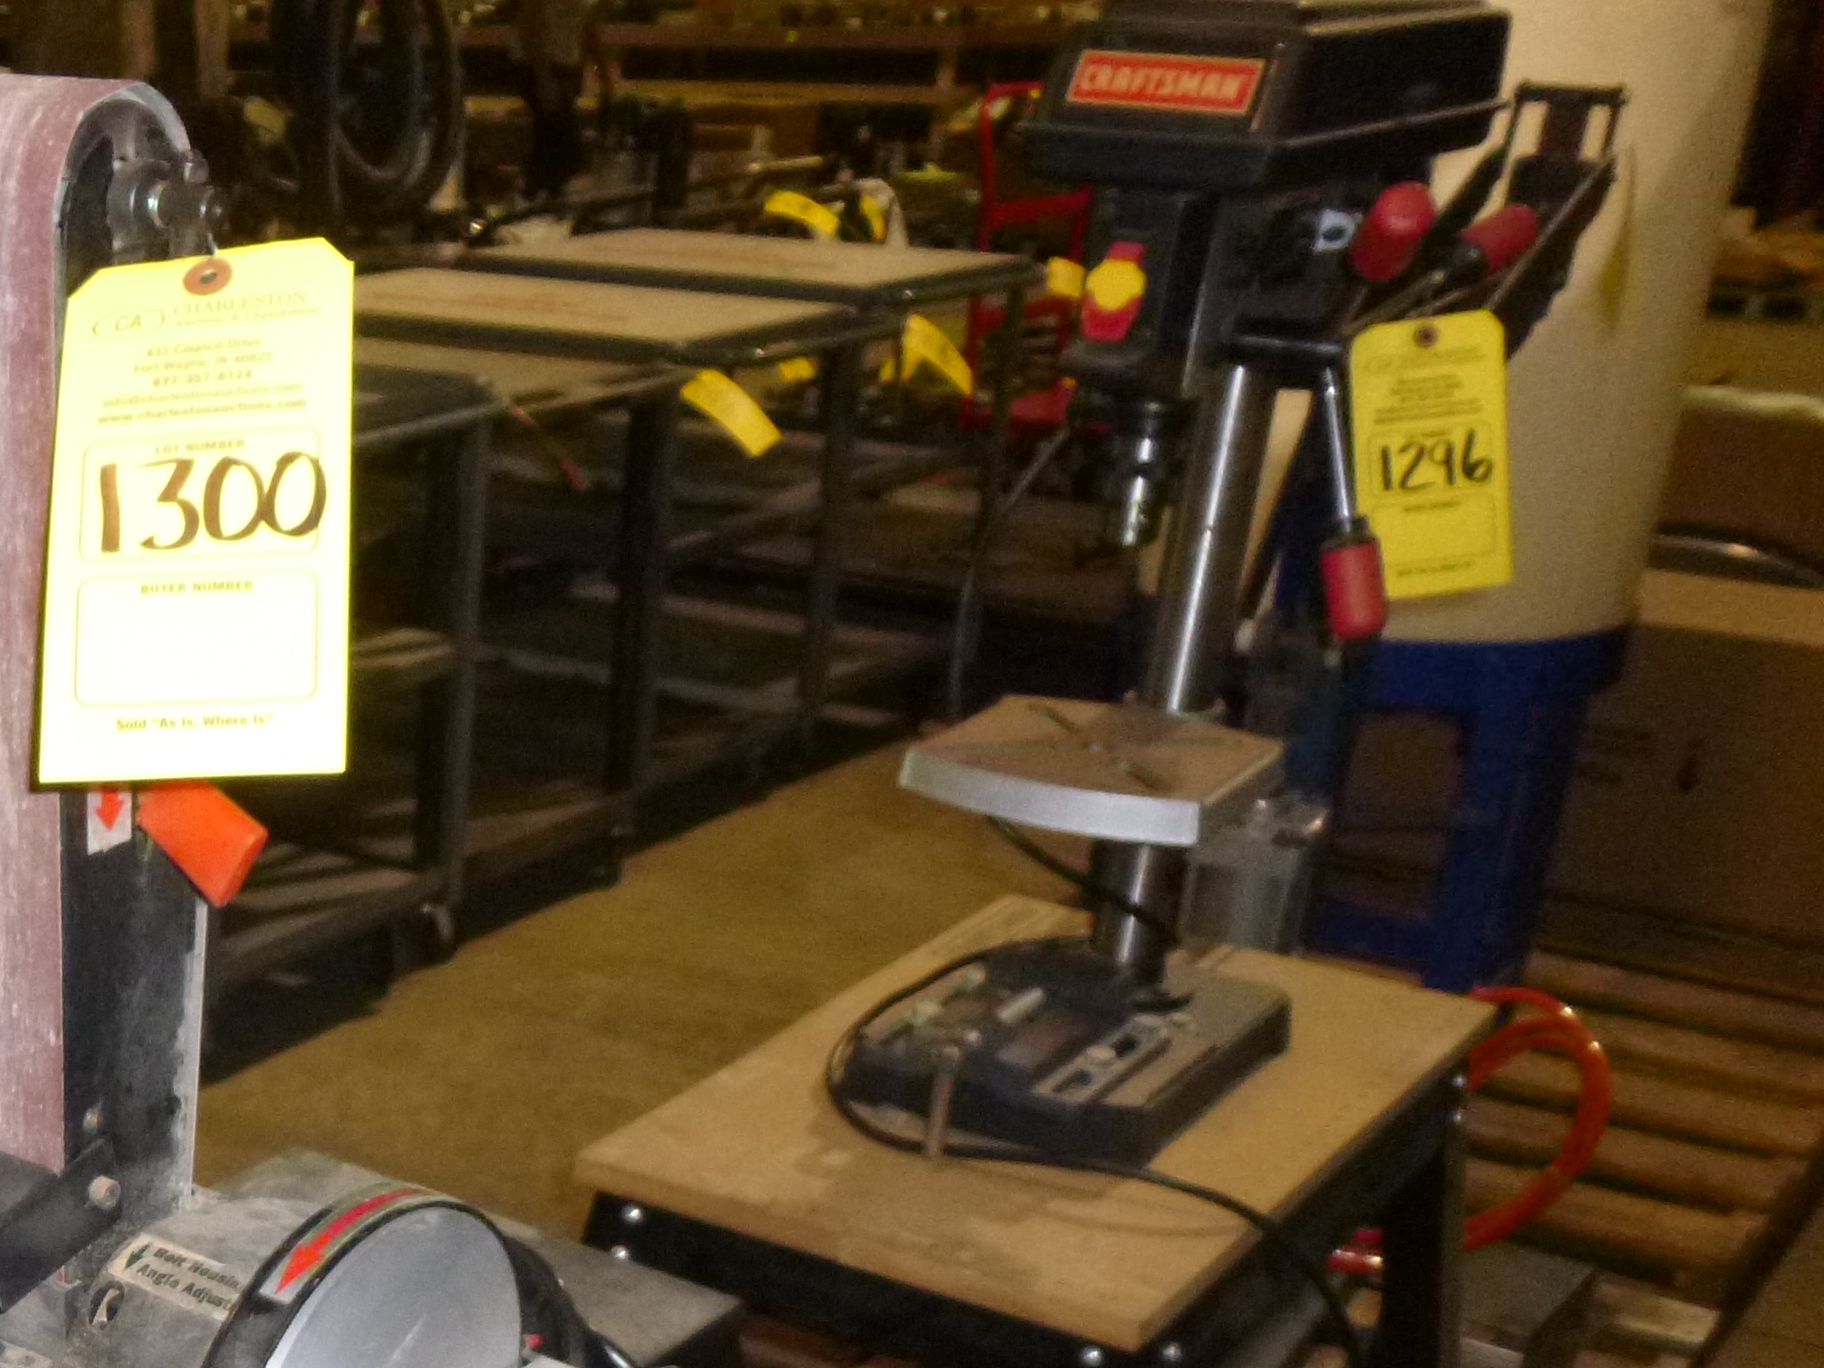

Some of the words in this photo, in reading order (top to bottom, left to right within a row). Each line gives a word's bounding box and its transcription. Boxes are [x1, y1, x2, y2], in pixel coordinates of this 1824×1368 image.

[1080, 63, 1245, 100] CRAFTSMAN
[114, 314, 142, 331] CA
[185, 438, 245, 452] NUMBER
[1381, 428, 1493, 491] 1296
[100, 451, 327, 553] 1300
[140, 582, 186, 594] BUYER
[192, 580, 253, 592] NUMBER
[116, 717, 147, 731] Sold
[202, 714, 248, 727] Where
[135, 1264, 181, 1288] Angle
[187, 1260, 243, 1293] Housin
